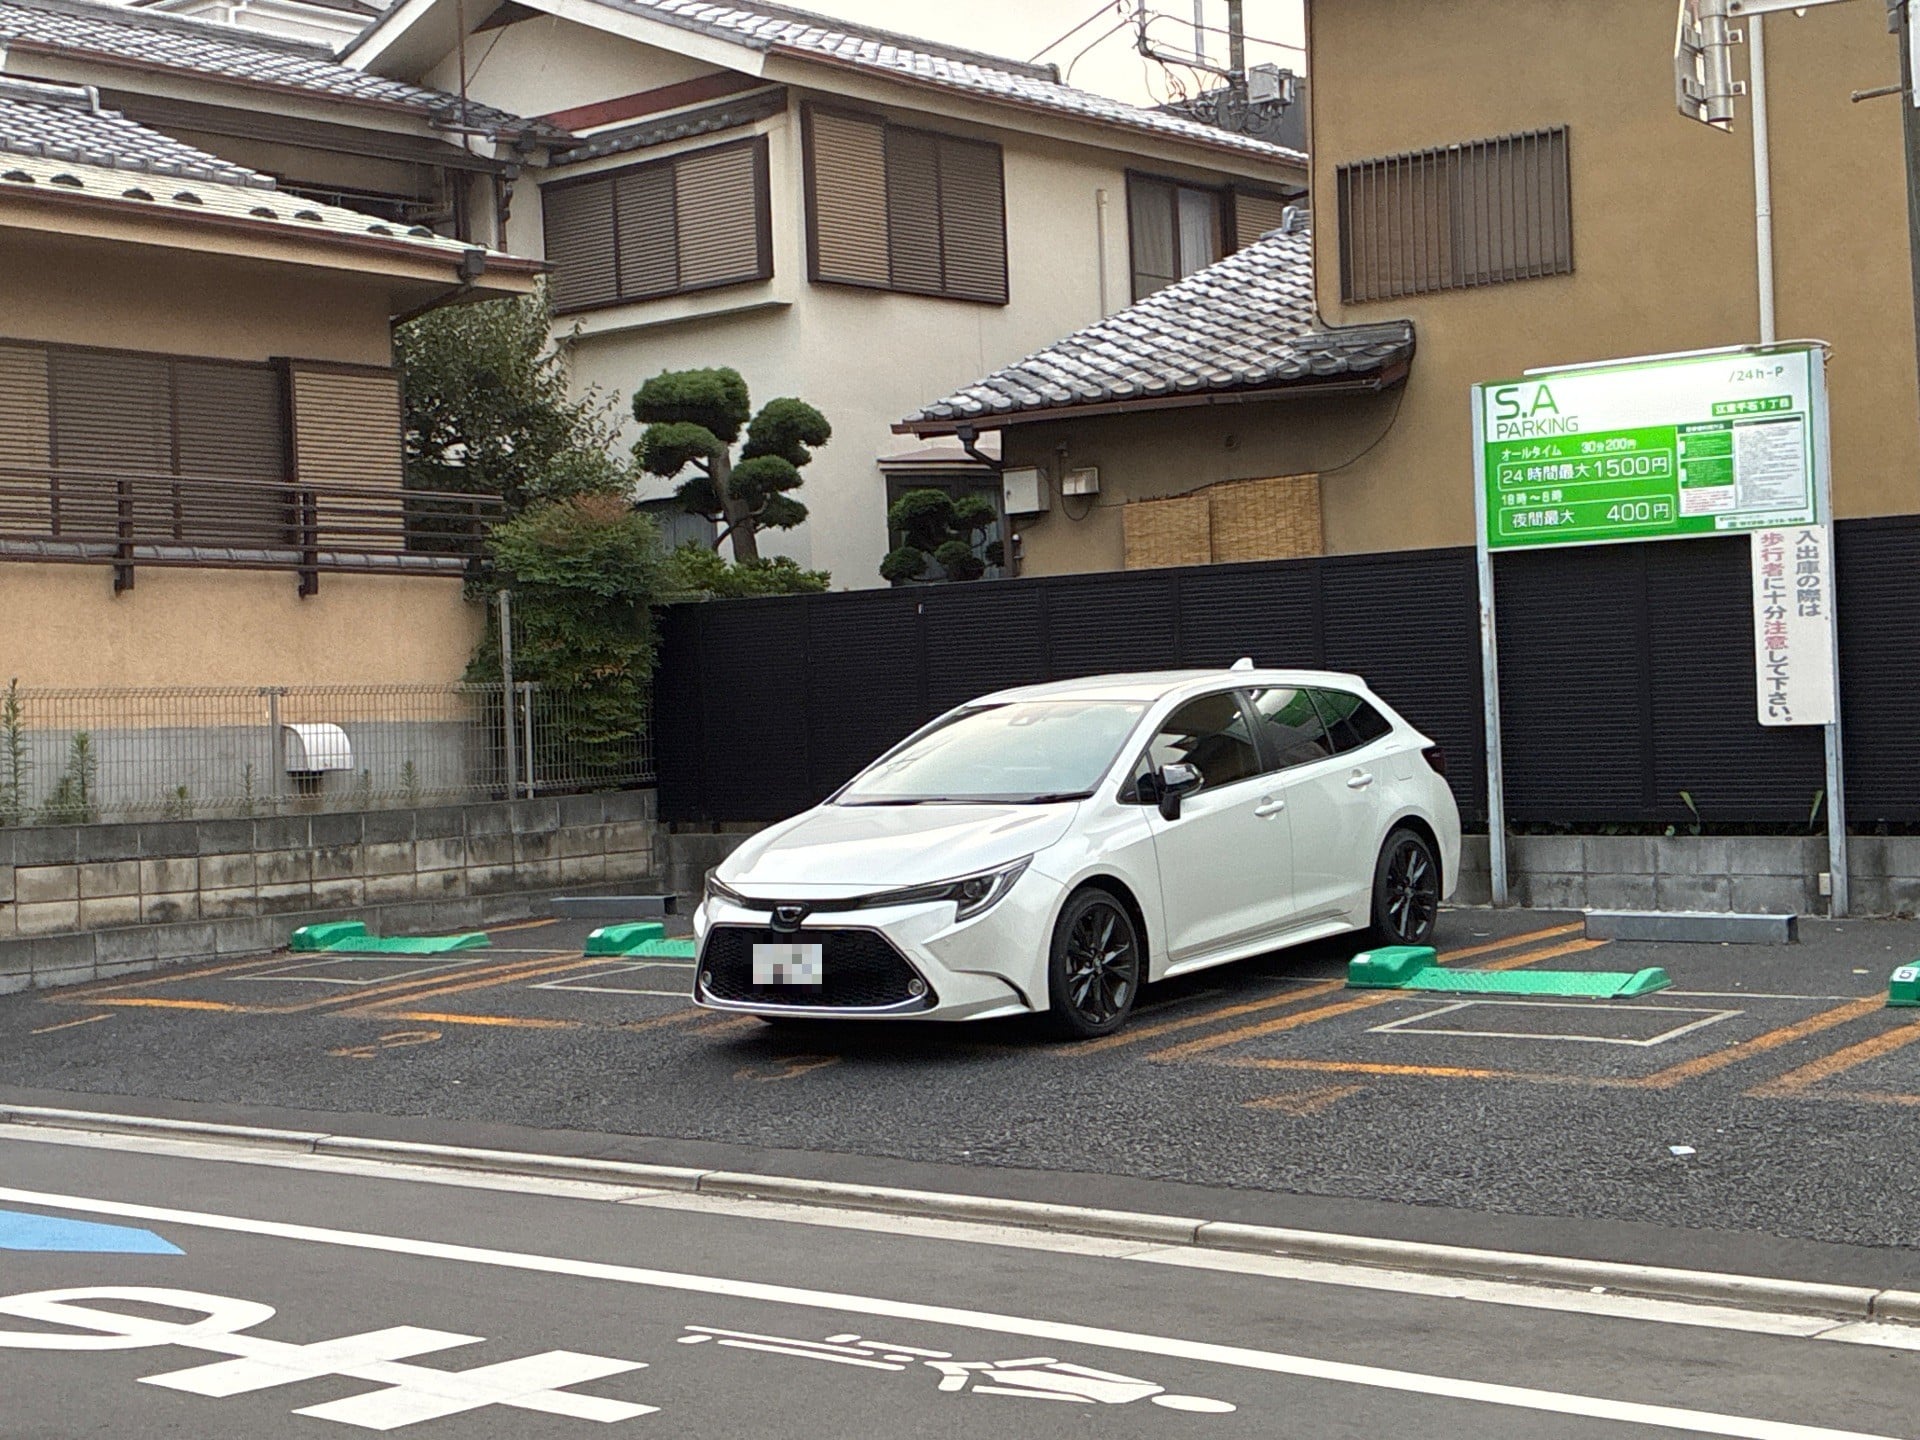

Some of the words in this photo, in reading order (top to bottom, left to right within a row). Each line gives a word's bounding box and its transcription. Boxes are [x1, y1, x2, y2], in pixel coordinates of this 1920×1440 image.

[1495, 383, 1560, 421] S.A
[1496, 415, 1579, 439] PARKING
[1501, 444, 1562, 461] オールタイム
[1512, 508, 1575, 529] 夜間最大
[1796, 530, 1821, 617] 入出庫の際は
[1761, 532, 1793, 722] 歩行者に十分注意して下さい。
[1899, 969, 1912, 980] 5
